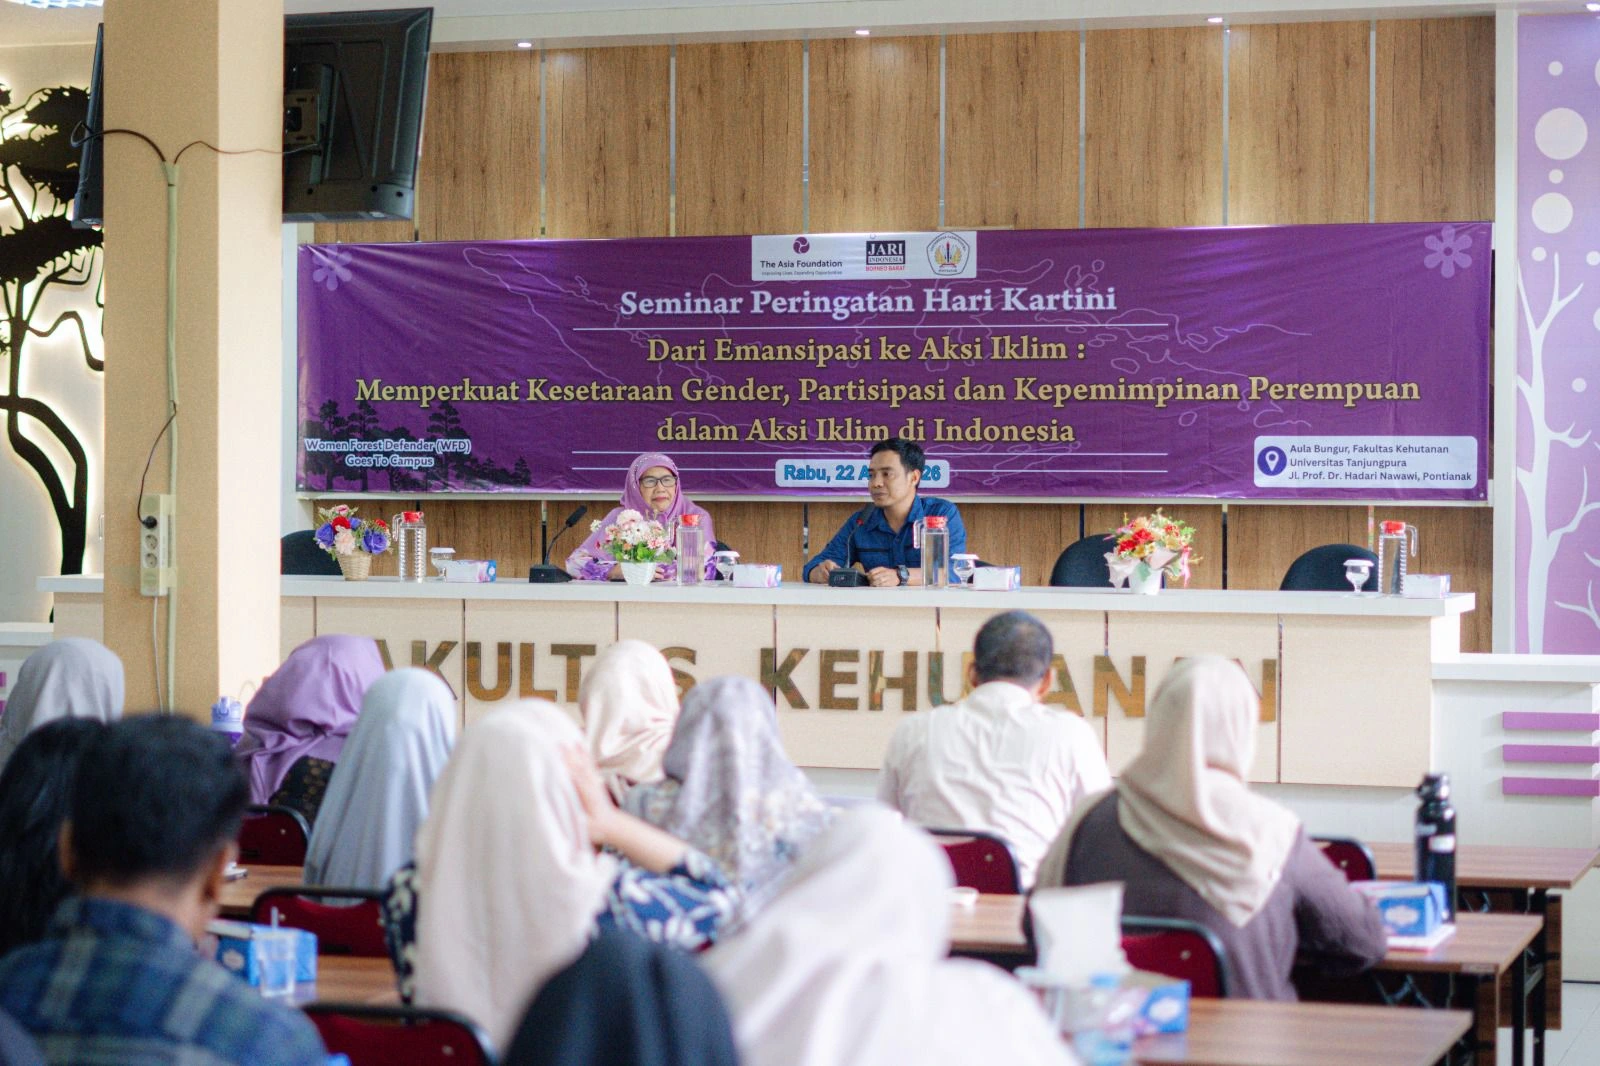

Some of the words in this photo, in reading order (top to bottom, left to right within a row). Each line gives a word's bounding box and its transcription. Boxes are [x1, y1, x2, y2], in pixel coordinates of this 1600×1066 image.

[868, 243, 903, 256] JARI
[797, 260, 843, 268] Foundation
[620, 291, 744, 315] Seminar
[750, 290, 915, 321] Peringatan
[922, 288, 994, 312] Hari
[1001, 287, 1118, 311] Kartini
[646, 338, 707, 362] Dari
[713, 337, 872, 368] Emansipasi
[879, 336, 911, 360] ke
[918, 335, 983, 361] Aksi
[990, 335, 1068, 360] Iklim
[1077, 343, 1085, 360] :
[355, 378, 520, 407] Memperkuat
[526, 378, 674, 402] Kesetaraan
[681, 377, 790, 406] Gender,
[798, 378, 946, 407] Partisipasi
[953, 376, 1006, 401] dan
[1013, 377, 1240, 408] Kepemimpinan
[1248, 376, 1421, 407] Perempuan
[657, 417, 739, 441] dalam
[748, 417, 808, 441] Aksi
[815, 417, 890, 441] Iklim
[898, 417, 926, 441] di
[933, 417, 1076, 441] Indonesia
[304, 439, 348, 452] Women
[350, 439, 383, 452] Forest
[384, 439, 435, 452] Defender
[436, 439, 471, 454] (WFD)
[1290, 445, 1312, 453] Aula
[1314, 444, 1351, 455] Bungur,
[1352, 444, 1393, 453] Fakultas
[1396, 444, 1449, 453] Kehutanan
[346, 454, 373, 467] Goes
[374, 454, 388, 467] To
[390, 454, 434, 469] Campus
[1290, 458, 1344, 467] Universitas
[1346, 459, 1407, 469] Tanjungpura
[784, 464, 831, 483] Rabu,
[836, 465, 855, 480] 22
[1302, 472, 1325, 480] Prof.
[1328, 472, 1342, 480] Dr.
[1345, 472, 1377, 480] Hadari
[1380, 472, 1421, 482] Nawawi,
[1423, 472, 1472, 481] Pontianak
